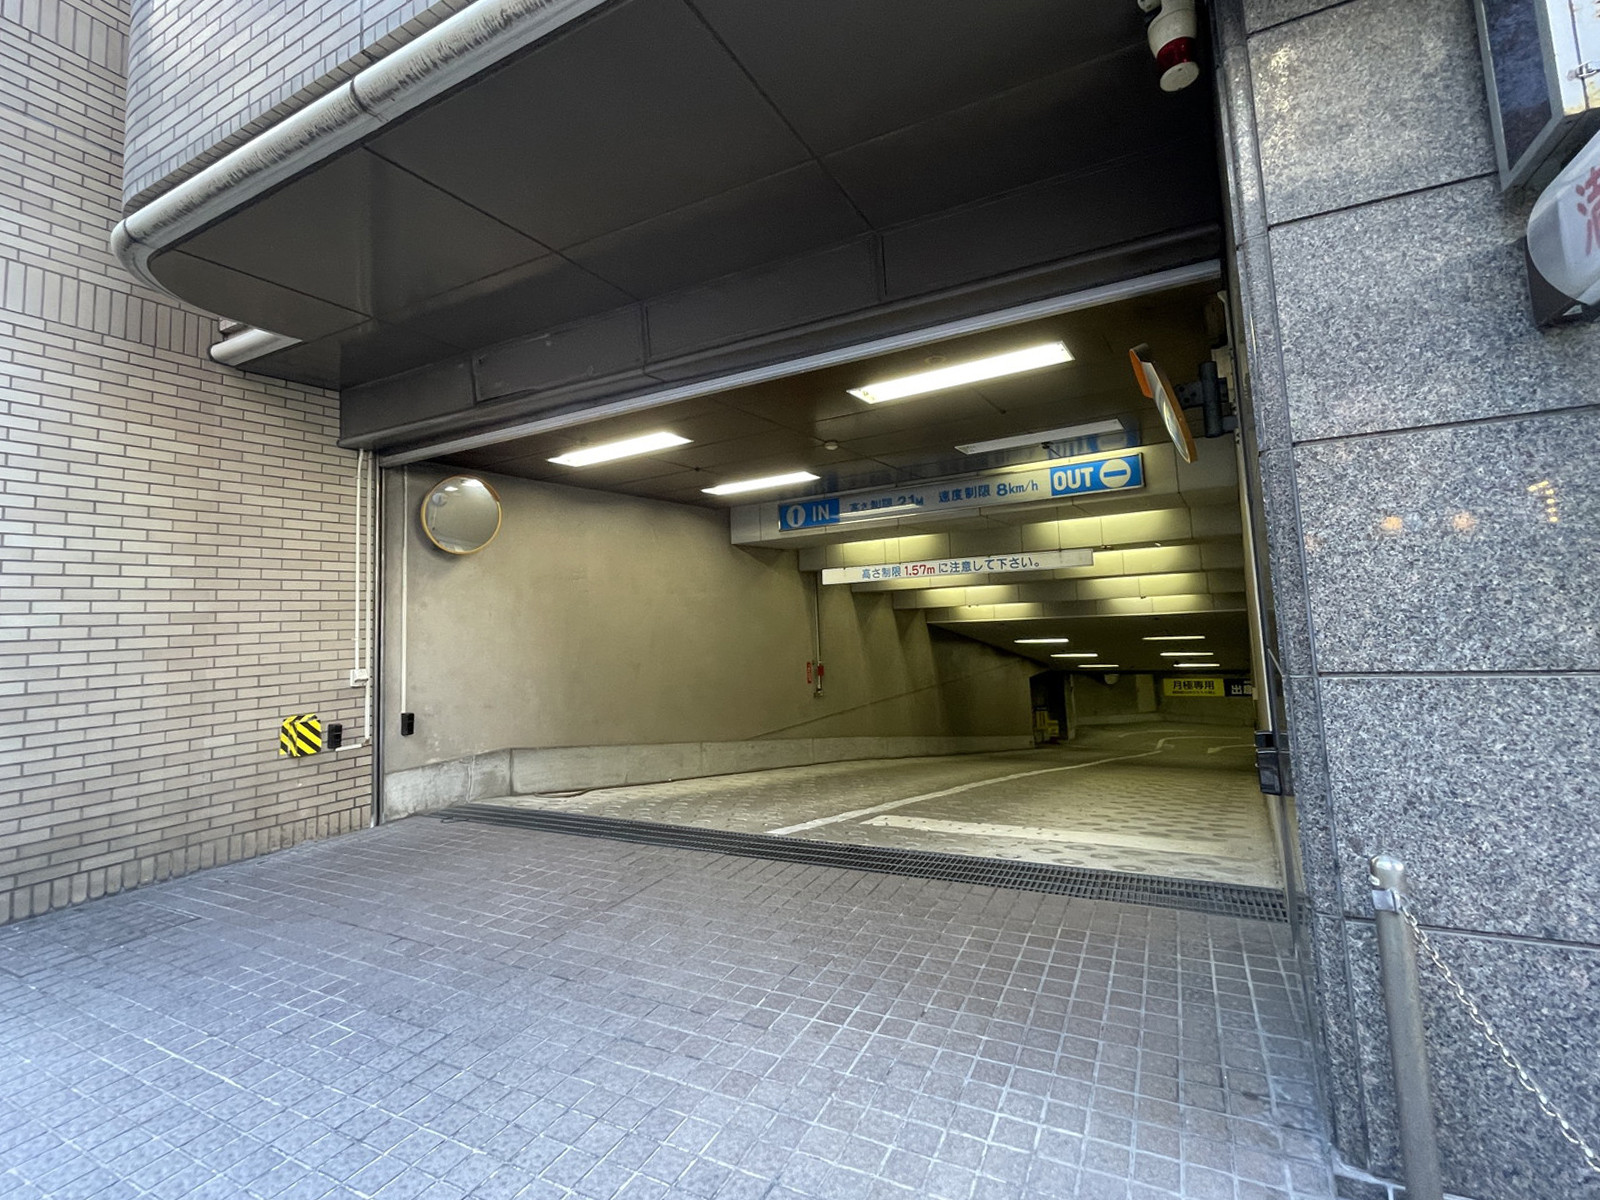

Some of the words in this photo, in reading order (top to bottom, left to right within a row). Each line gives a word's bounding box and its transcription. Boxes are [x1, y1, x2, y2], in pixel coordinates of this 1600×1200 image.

[1053, 467, 1094, 491] OUT
[938, 484, 991, 503] 速度制限
[996, 480, 1038, 497] 8km/h
[812, 504, 830, 522] IN
